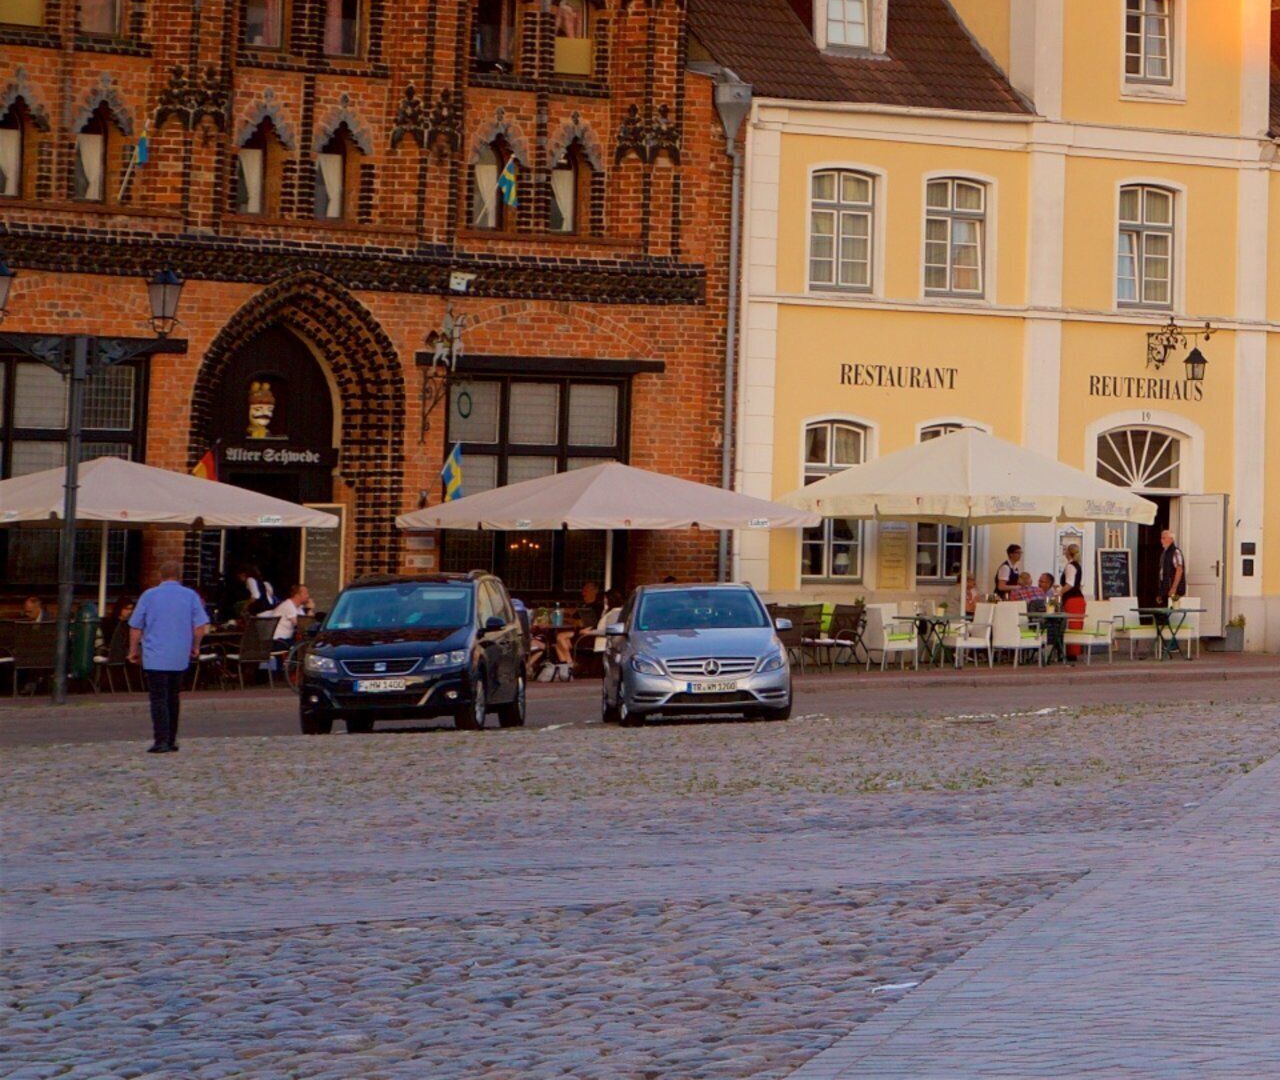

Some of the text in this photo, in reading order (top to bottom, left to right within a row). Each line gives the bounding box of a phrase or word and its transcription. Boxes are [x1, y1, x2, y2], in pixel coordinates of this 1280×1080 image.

[839, 363, 959, 390] RESTAURANT
[1089, 375, 1203, 402] REUTERHAUS
[1141, 411, 1151, 422] 19
[225, 447, 320, 465] Alter Schwede
